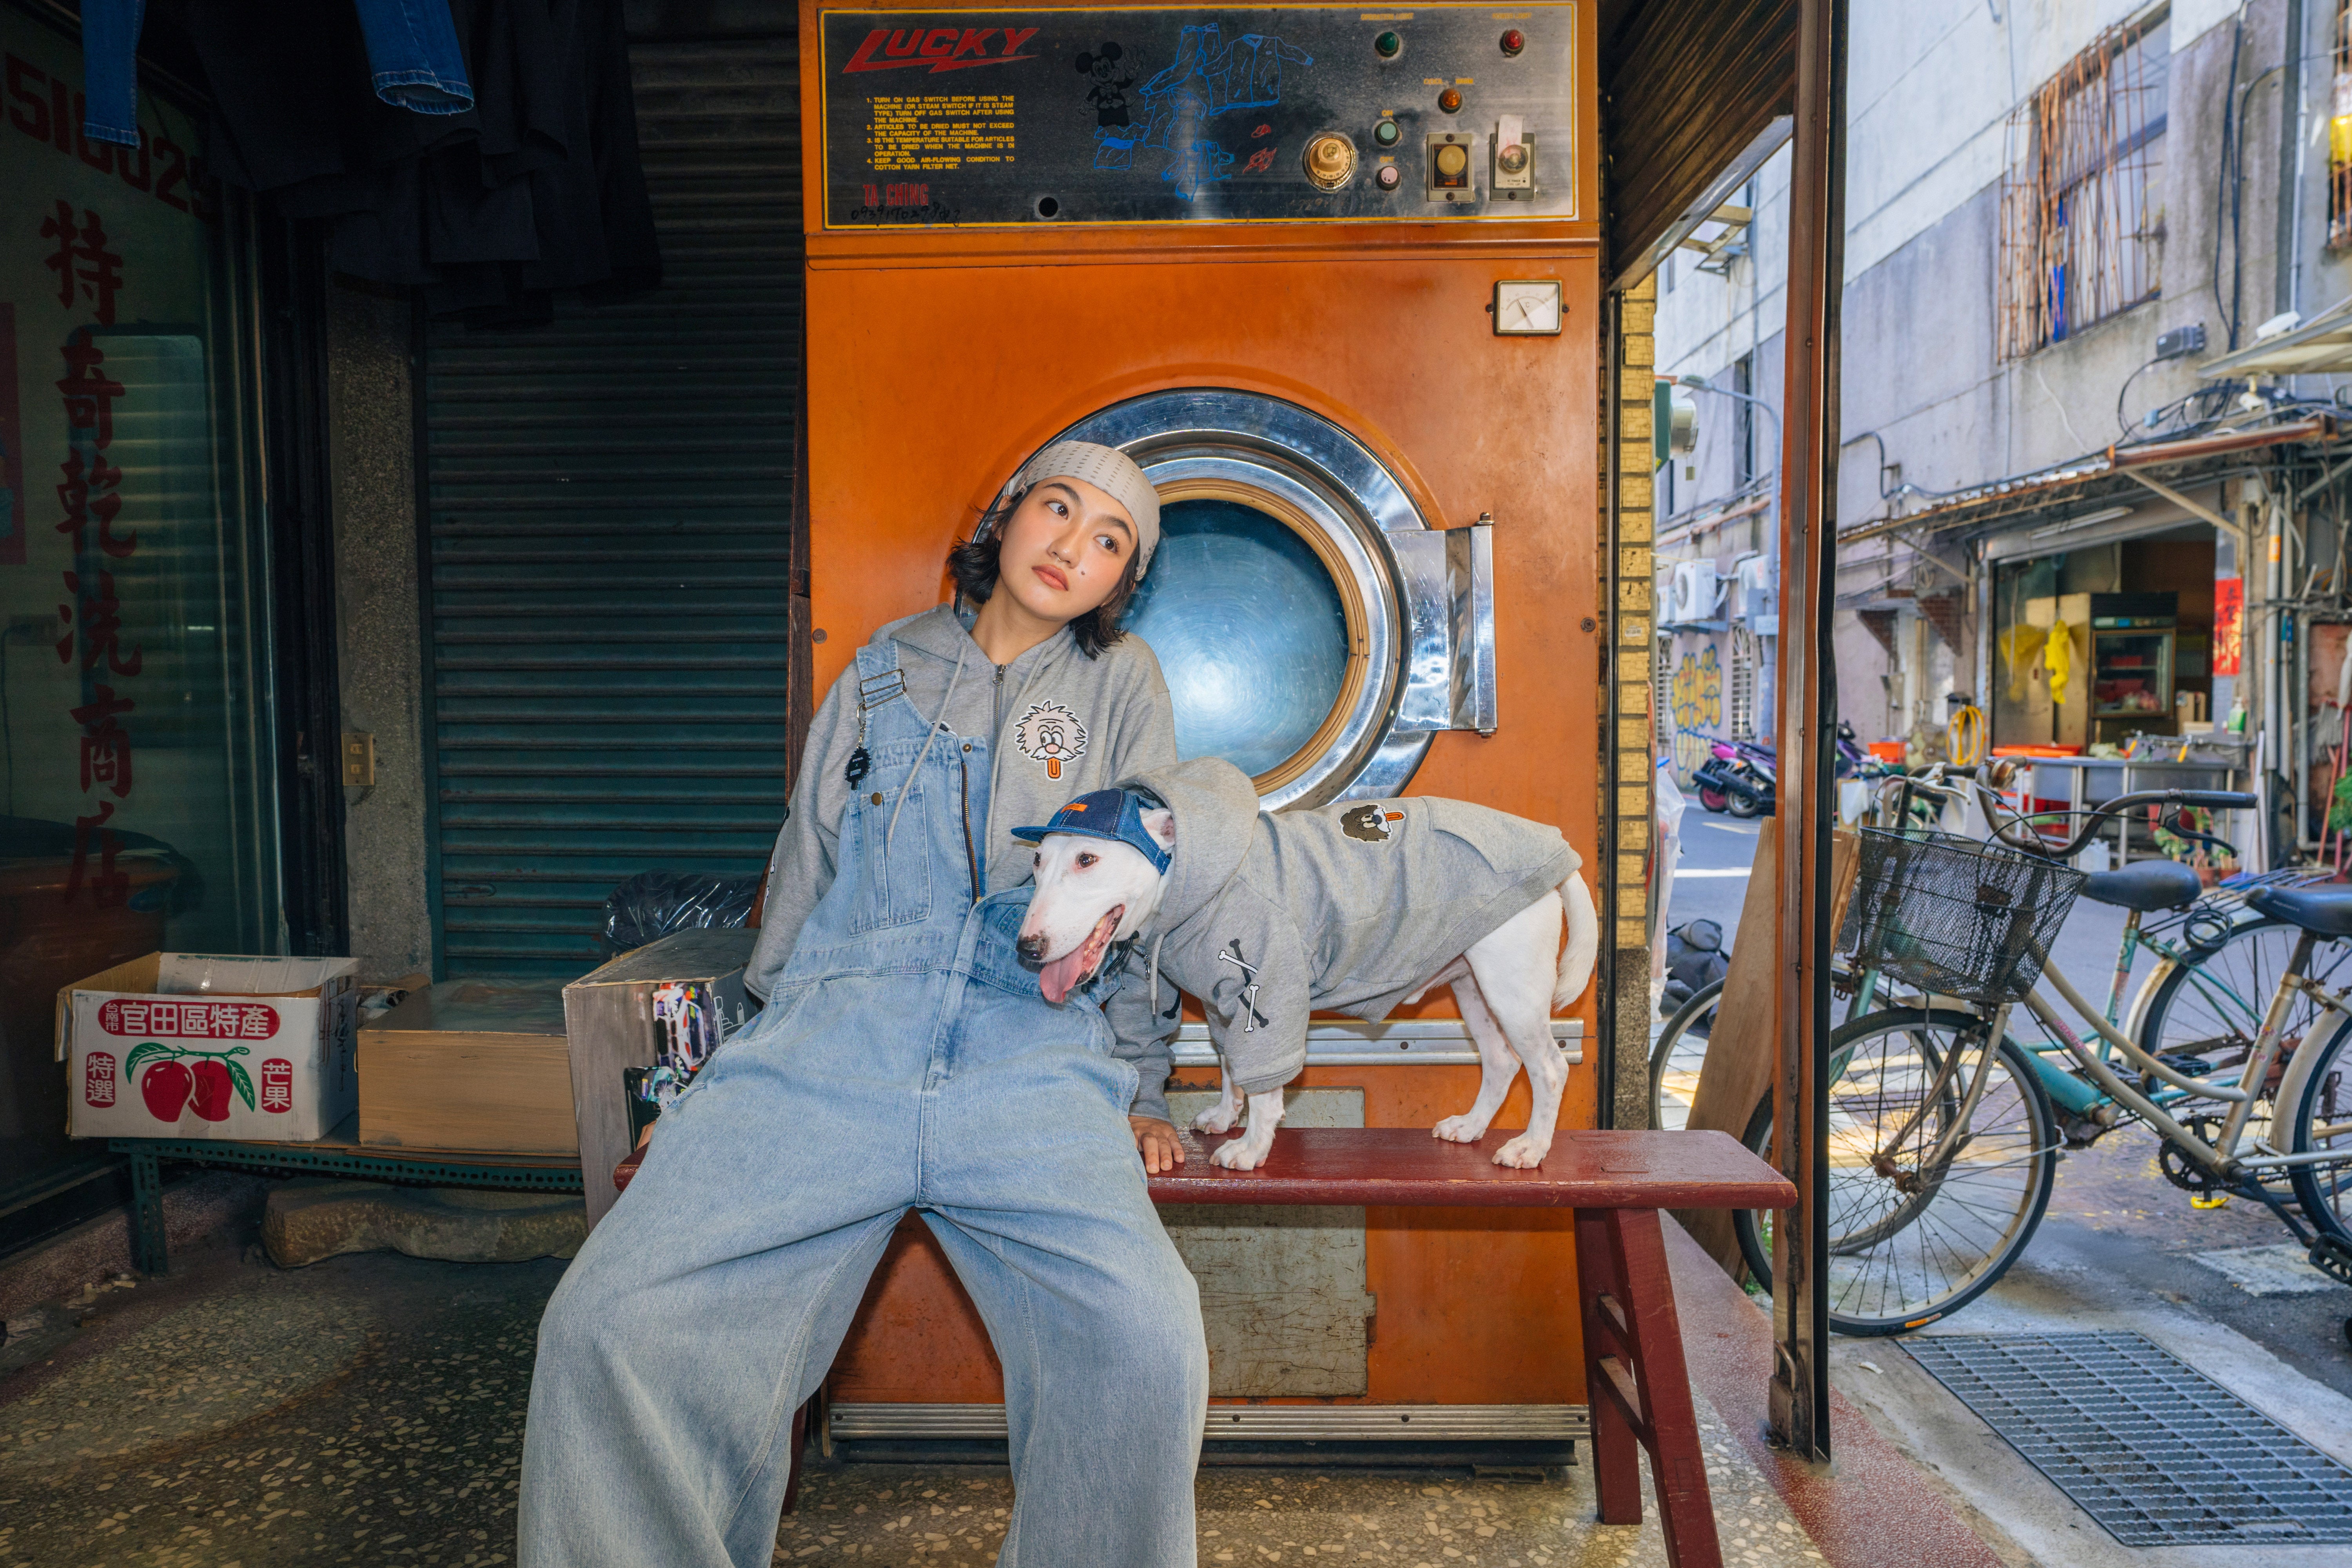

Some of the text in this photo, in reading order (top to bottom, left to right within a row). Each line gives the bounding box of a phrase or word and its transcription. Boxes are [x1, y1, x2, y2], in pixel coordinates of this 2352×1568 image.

[842, 27, 1040, 73] LUCKY
[863, 183, 928, 206] TA CHING
[40, 200, 142, 909] 特奇乾洗商店
[105, 1002, 118, 1031] 台南市
[120, 1002, 269, 1037] 官田區特產
[87, 1055, 114, 1103] 特選
[263, 1063, 290, 1109] 芒果
